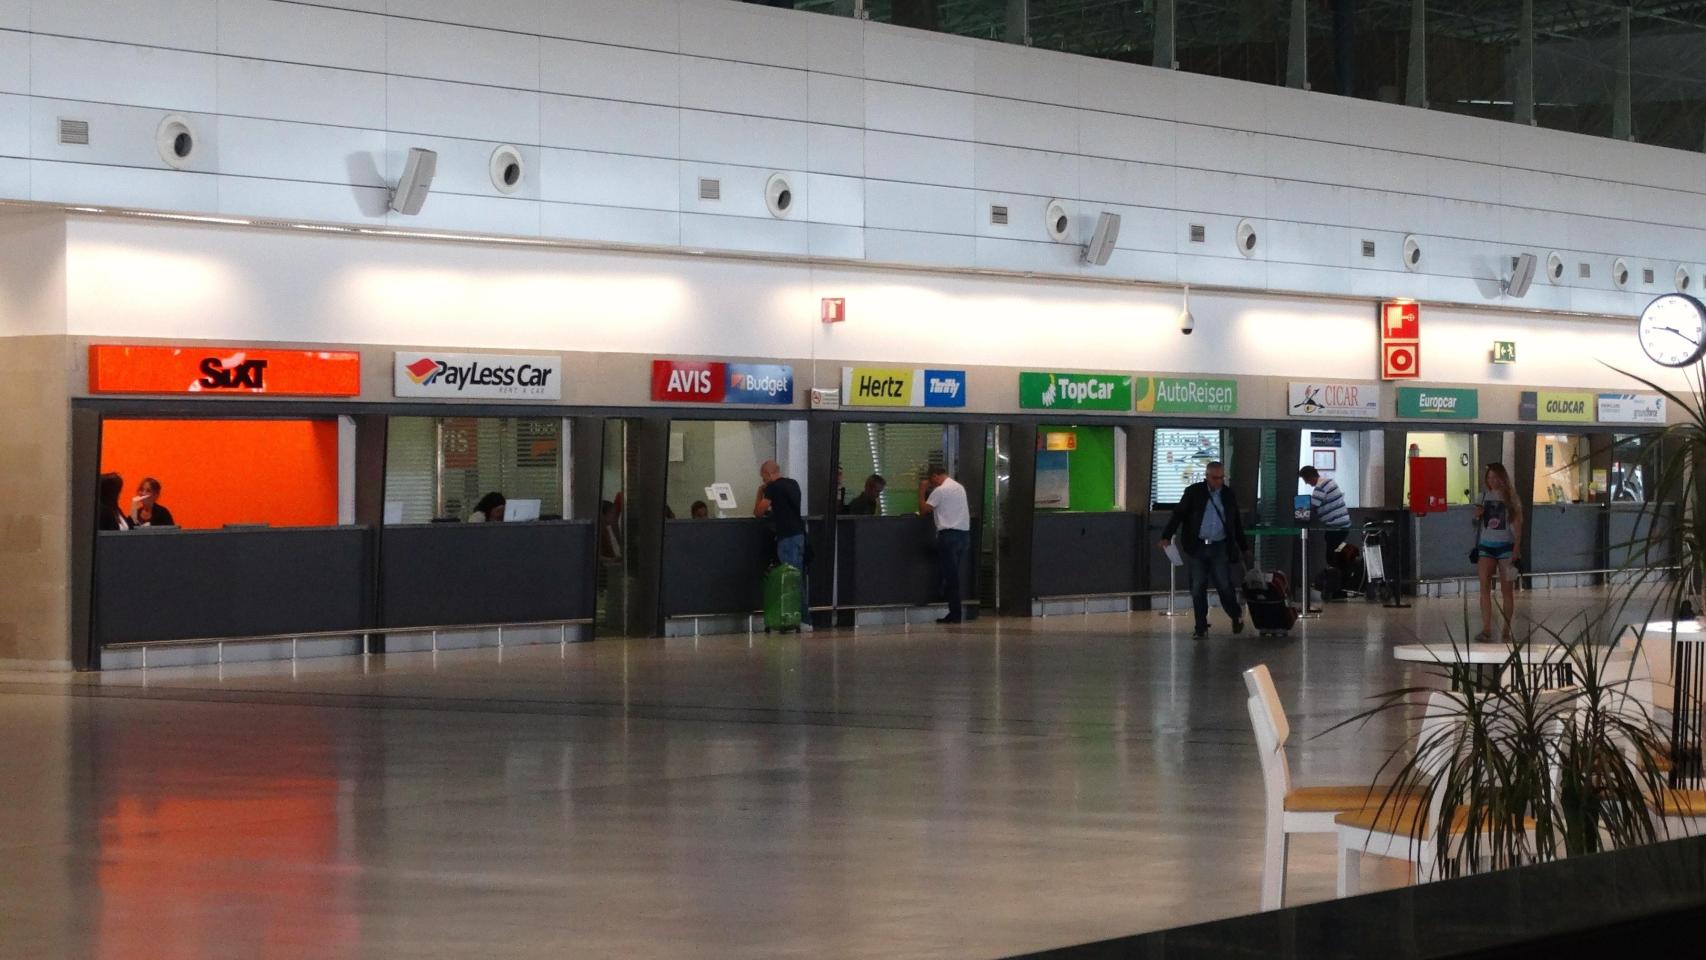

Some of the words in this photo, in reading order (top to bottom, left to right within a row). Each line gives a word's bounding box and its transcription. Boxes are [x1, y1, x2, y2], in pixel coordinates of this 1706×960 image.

[518, 365, 552, 386] Car
[667, 370, 711, 393] AVIS
[747, 375, 788, 396] Budget
[859, 376, 904, 397] Hertz
[1058, 378, 1114, 404] TopCar
[1157, 381, 1232, 404] AutoReisen
[1325, 385, 1358, 406] CICAR
[1419, 393, 1457, 412] Europcar
[1546, 400, 1584, 414] GOLDCAR
